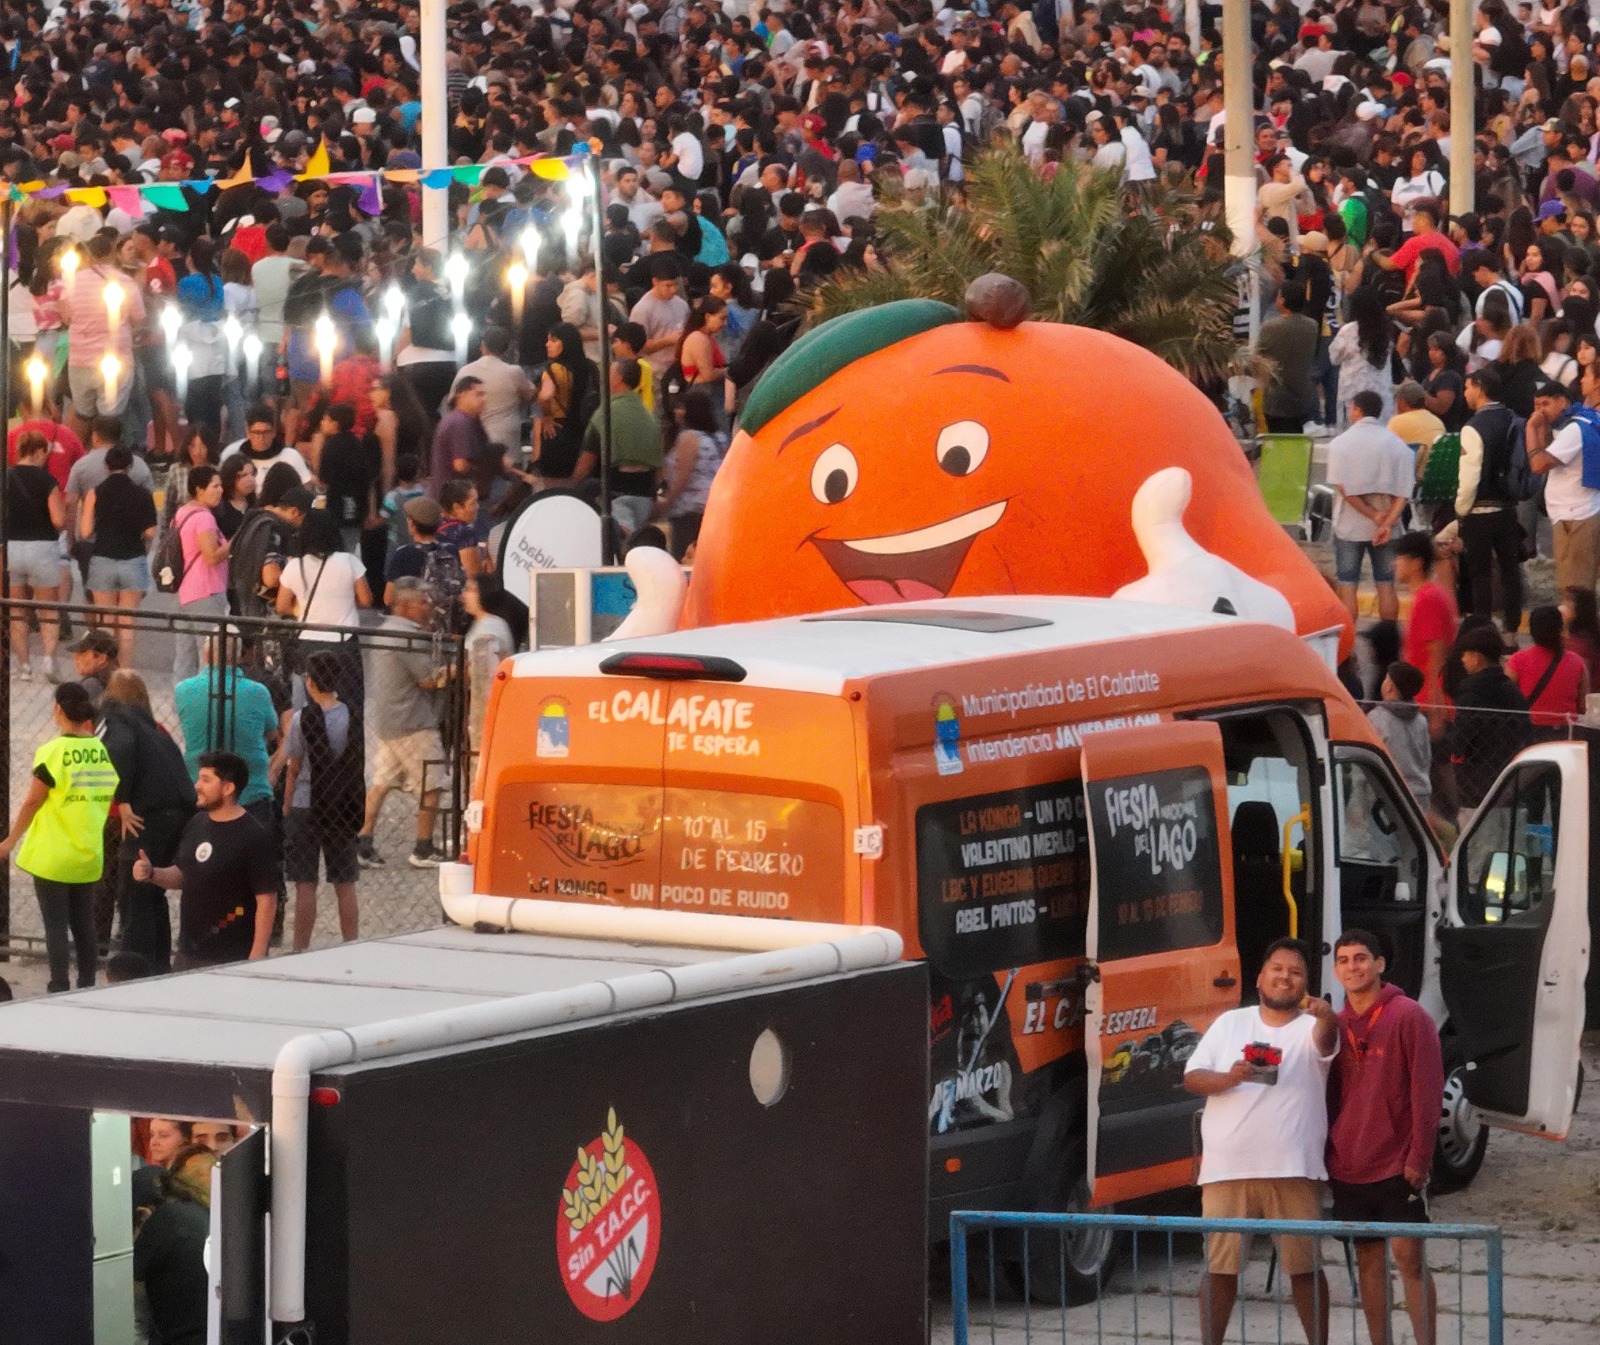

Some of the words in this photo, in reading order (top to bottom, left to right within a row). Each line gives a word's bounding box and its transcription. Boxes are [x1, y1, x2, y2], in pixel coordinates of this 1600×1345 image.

[589, 701, 609, 723] EL
[611, 689, 754, 734] CALAFATE
[962, 680, 1065, 719] Municipalidad
[1066, 679, 1085, 702] de
[1086, 676, 1099, 700] El
[1100, 670, 1159, 697] Calafate
[668, 733, 687, 753] TE
[693, 734, 760, 757] ESPERA
[966, 728, 1053, 763] Intendencia
[528, 801, 594, 830] FIESTA
[1035, 799, 1054, 824] UN
[1104, 783, 1160, 838] FIESTA
[557, 833, 575, 846] DEL
[576, 831, 641, 861] LAGO
[682, 816, 704, 838] 10
[711, 817, 735, 841] AL
[745, 819, 768, 842] 15
[680, 846, 707, 870] DE
[715, 847, 804, 877] FEBRERO
[960, 835, 1031, 868] VALENTINO
[1033, 829, 1075, 857] MERLO
[1150, 819, 1197, 875] LAGO
[630, 882, 654, 901] UN
[661, 885, 704, 905] POCO
[709, 887, 732, 906] DE
[737, 890, 789, 910] RUIDO
[955, 907, 989, 934] ABEL
[991, 899, 1037, 928] PINTOS
[1023, 1001, 1047, 1035] EL
[1106, 1005, 1157, 1035] ESPERA
[956, 1061, 1003, 1102] MARZO
[567, 1243, 595, 1281] Sin
